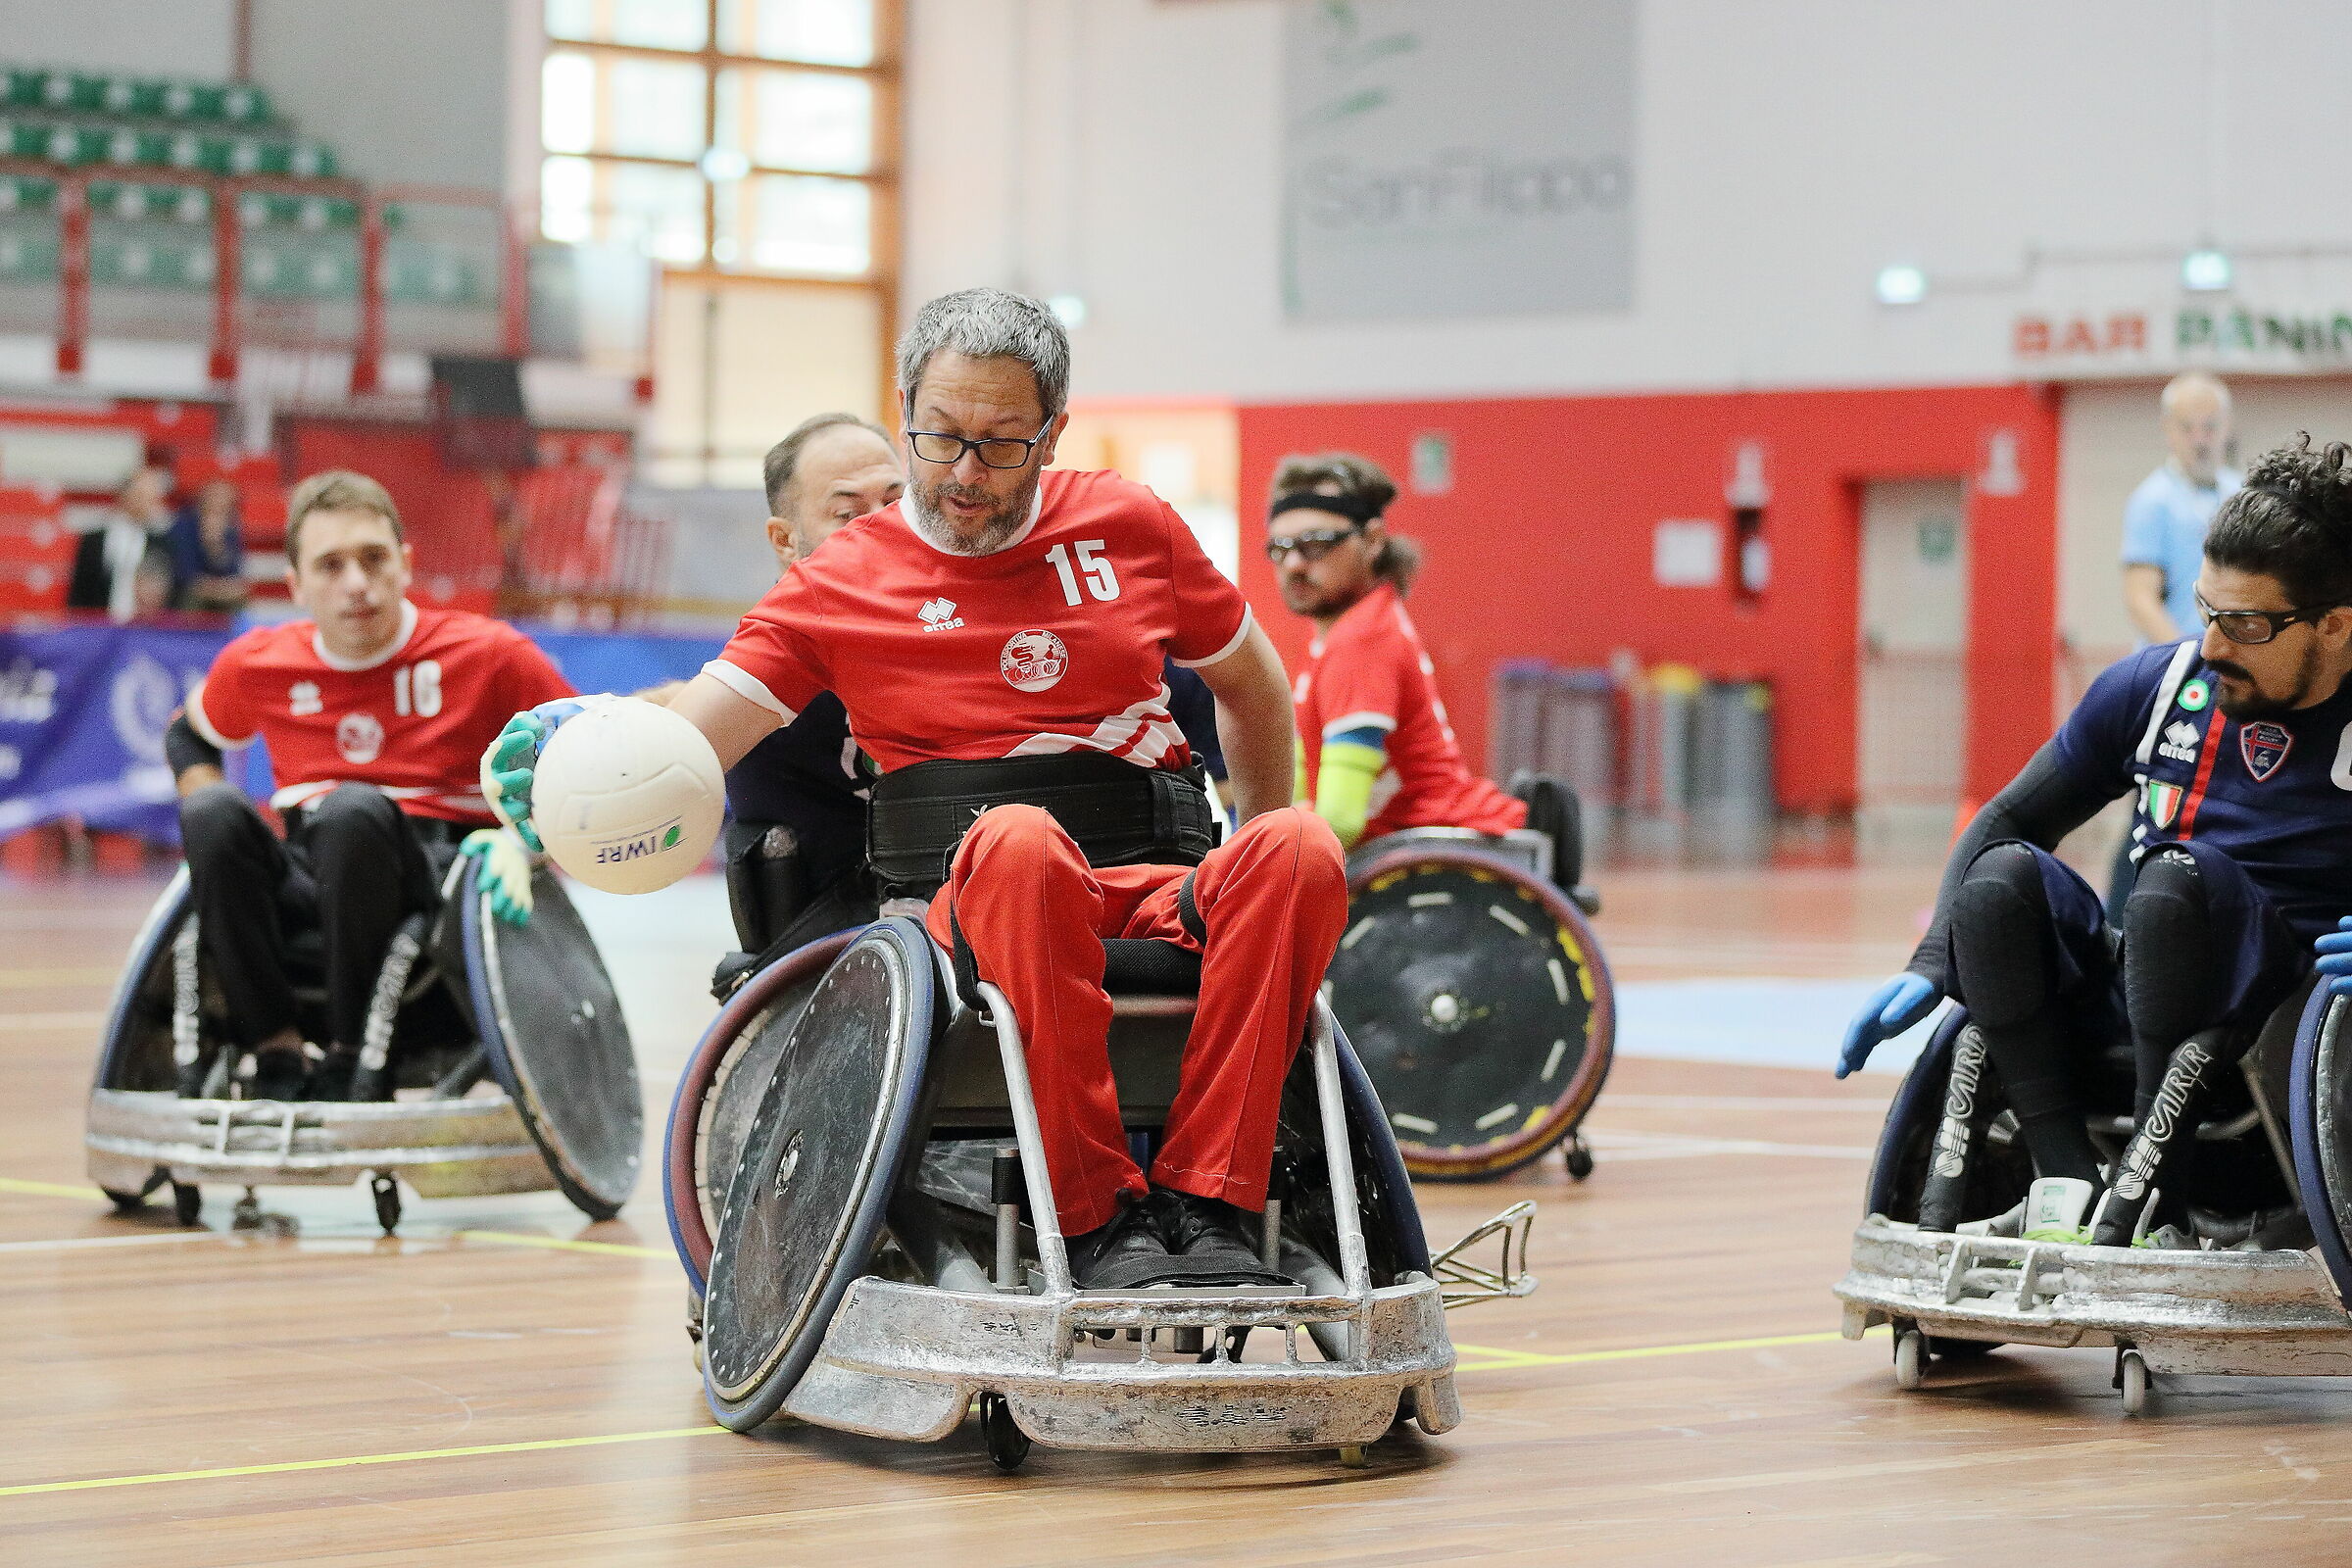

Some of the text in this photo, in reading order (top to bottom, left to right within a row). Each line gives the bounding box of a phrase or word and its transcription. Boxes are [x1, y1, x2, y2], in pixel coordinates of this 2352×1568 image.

[2014, 312, 2147, 352] BAR
[1045, 539, 1120, 606] 15
[394, 660, 442, 717] 16
[597, 835, 656, 863] IWRF
